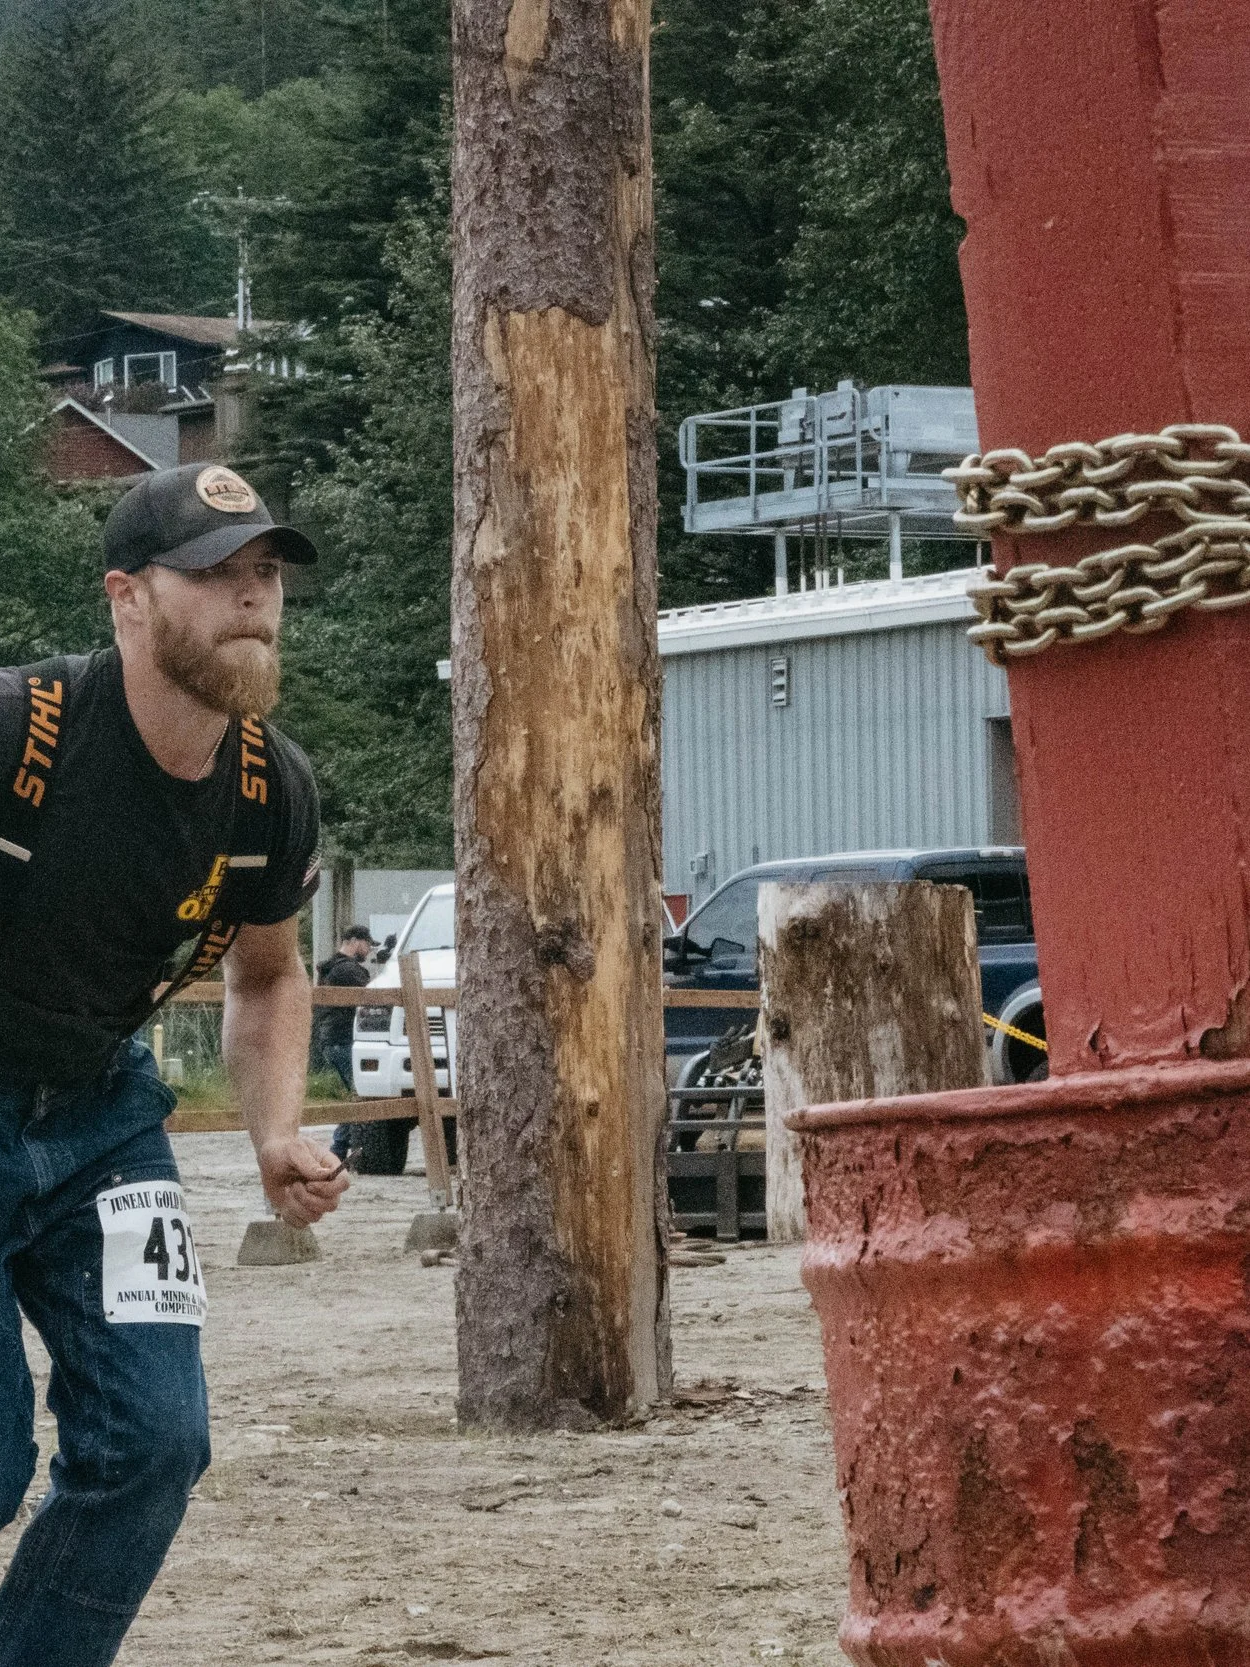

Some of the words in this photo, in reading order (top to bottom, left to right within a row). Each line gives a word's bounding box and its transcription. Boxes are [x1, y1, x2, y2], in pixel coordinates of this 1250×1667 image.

[13, 679, 63, 808] STIHL
[241, 713, 267, 805] STIH
[110, 1191, 151, 1215] JUNEAU
[154, 1190, 180, 1210] GOLD
[117, 1290, 158, 1303] ANNUAL
[161, 1290, 191, 1303] MINING
[191, 1293, 197, 1304] &
